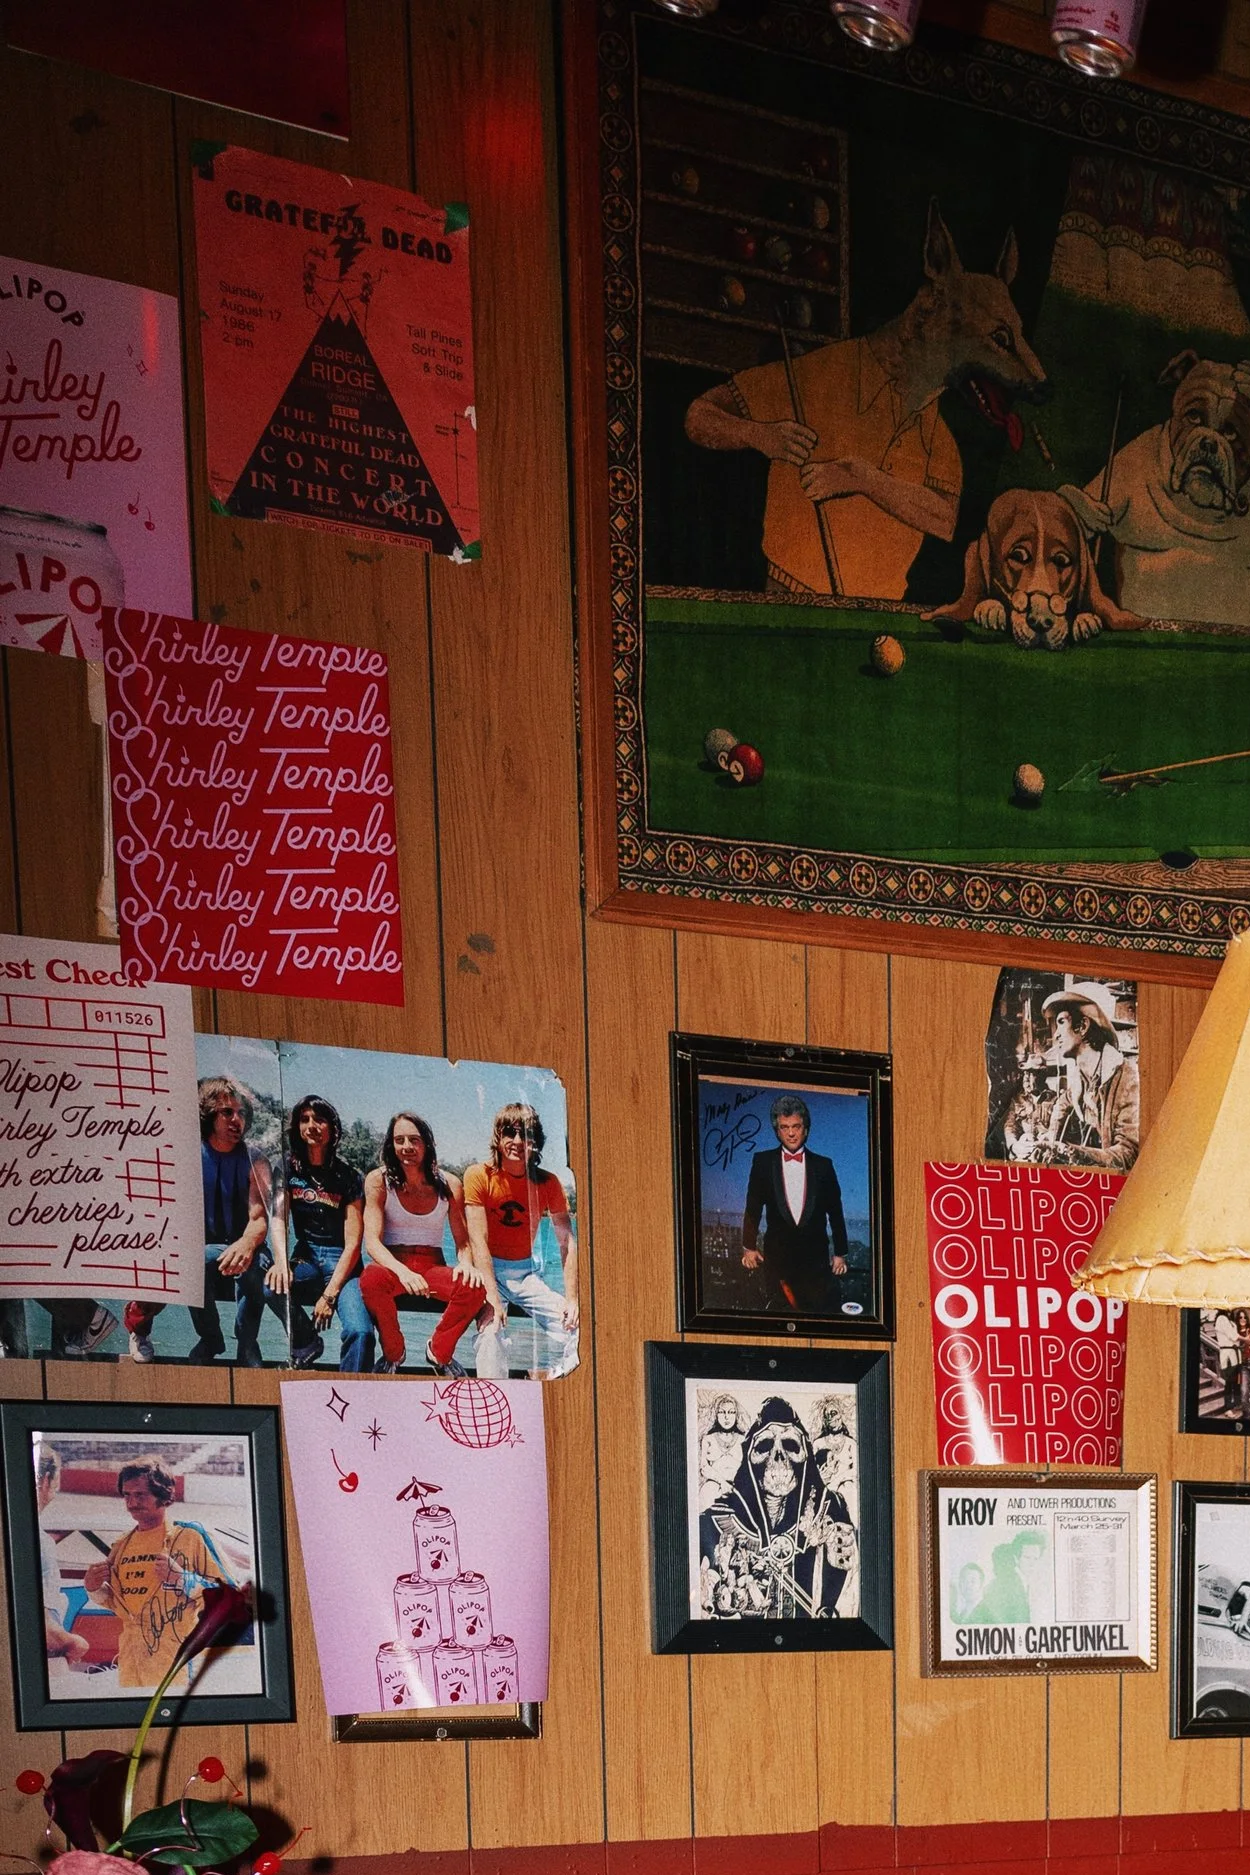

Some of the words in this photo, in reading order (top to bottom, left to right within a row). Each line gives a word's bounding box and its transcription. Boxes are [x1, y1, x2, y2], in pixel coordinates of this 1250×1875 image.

[381, 226, 454, 264] DEAD
[219, 280, 264, 303] Sunday
[220, 298, 263, 318] August
[223, 314, 255, 332] 1986
[222, 331, 231, 343] 2
[235, 337, 254, 349] pm
[406, 324, 427, 339] Tall
[431, 330, 463, 348] Pines
[313, 344, 370, 368] BOREAL
[311, 361, 376, 391] RIDGE
[435, 364, 463, 380] Slide
[281, 405, 316, 423] THE
[329, 417, 409, 444] HIGHEST
[270, 424, 365, 457] GRATEFUL
[370, 445, 421, 468] DEAD
[261, 445, 432, 497] CONCERT
[250, 471, 278, 492] IN
[287, 479, 341, 505] THE
[351, 491, 444, 526] WORLD
[105, 607, 251, 683] Shirley
[110, 663, 254, 744] Shirley
[256, 683, 390, 745] Temple
[113, 725, 258, 806] Shirley
[260, 743, 393, 806] Temple
[117, 788, 261, 867] Shirley
[263, 802, 396, 866] Temple
[120, 850, 264, 927] Shirley
[266, 862, 399, 926] Temple
[125, 912, 268, 987] Shirley
[269, 921, 402, 985] Temple
[94, 1010, 154, 1027] 011526
[61, 1106, 165, 1151] Temple
[30, 1158, 103, 1187] extra
[8, 1191, 134, 1227] cherries,
[64, 1217, 169, 1269] please!
[934, 1284, 1124, 1334] OLIPOP
[938, 1334, 1124, 1383] OLIPOP
[941, 1383, 1122, 1430] OLIPOP
[947, 1498, 998, 1526] KROY
[1007, 1498, 1026, 1509] AND
[1029, 1498, 1059, 1509] TOWER
[1061, 1497, 1117, 1509] PRODUCTIONS
[1090, 1516, 1127, 1524] Survey
[421, 1535, 451, 1548] OLIPOP
[121, 1553, 158, 1565] DAMN
[126, 1571, 146, 1580] I'M
[402, 1603, 432, 1616] OLIPOP
[457, 1601, 485, 1615] OLIPOP
[955, 1627, 1015, 1656] SIMON
[1025, 1624, 1129, 1653] GARFUNKEL
[441, 1667, 470, 1680] OLIPOP
[490, 1665, 514, 1678] OLIPOP
